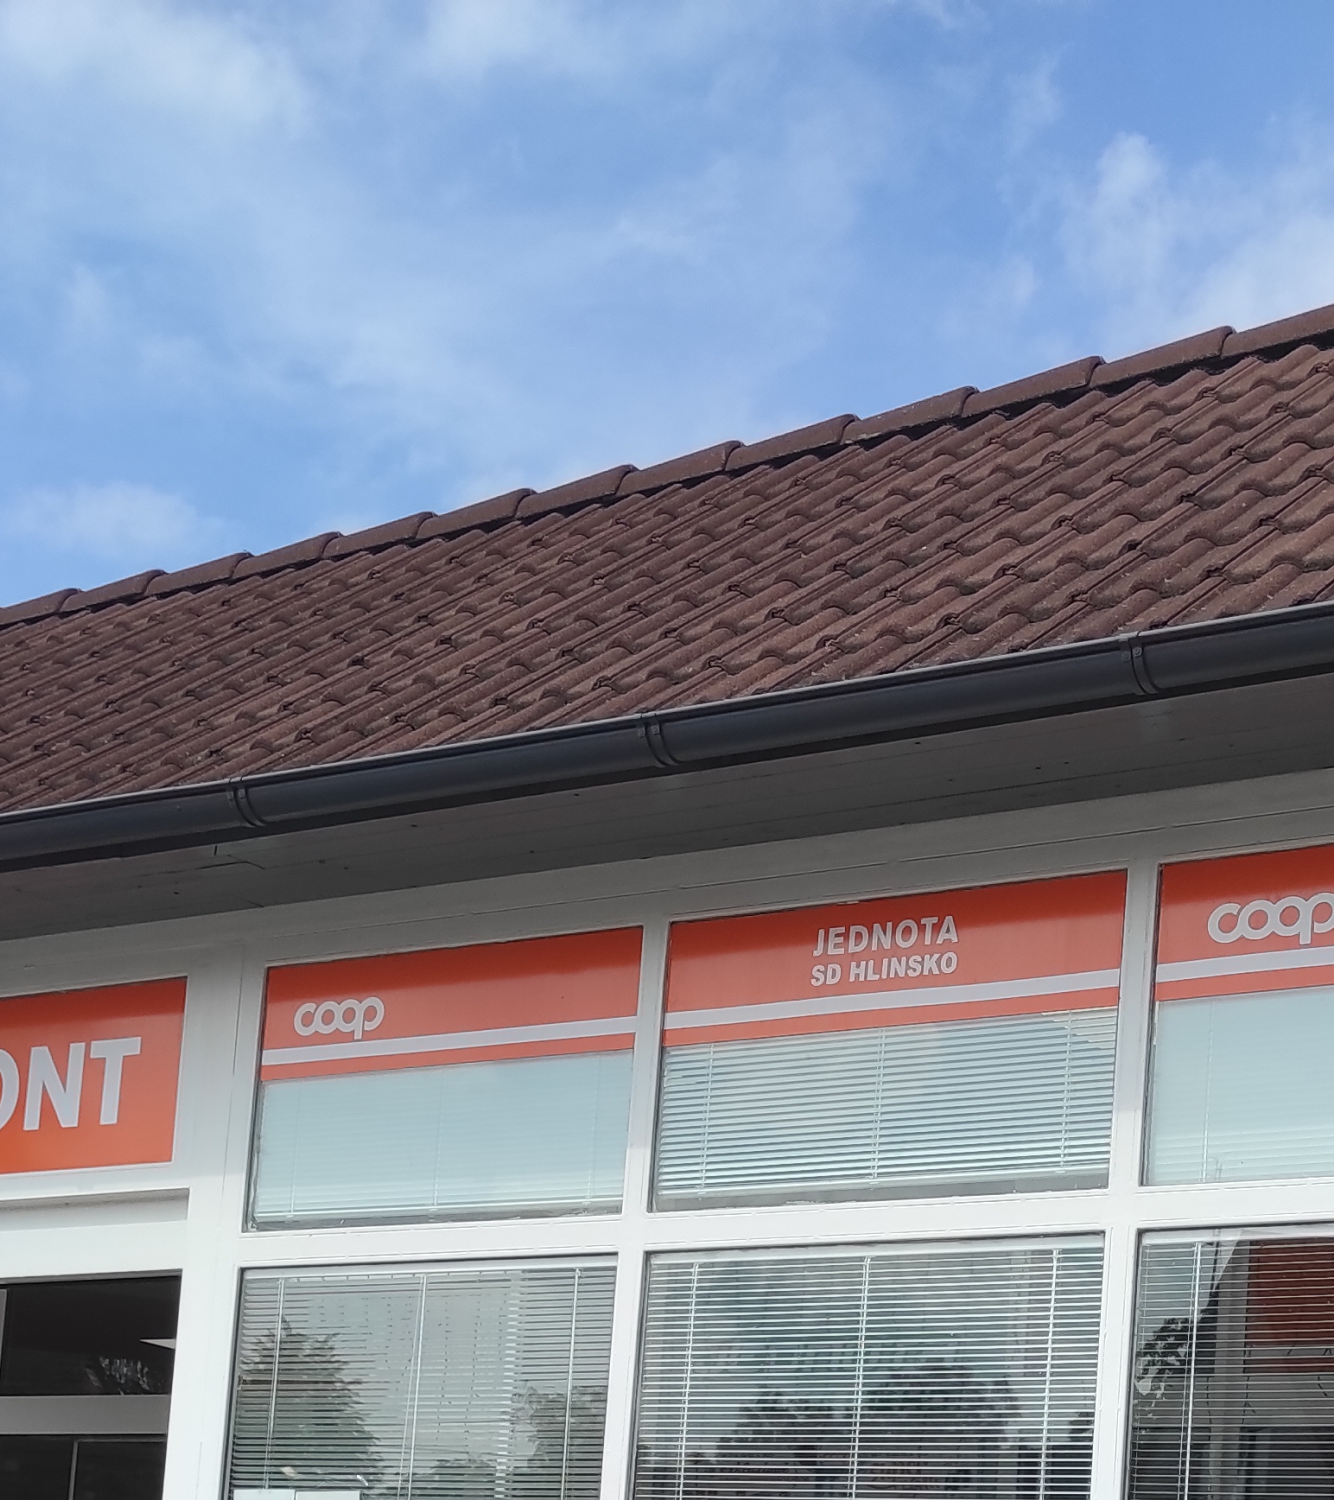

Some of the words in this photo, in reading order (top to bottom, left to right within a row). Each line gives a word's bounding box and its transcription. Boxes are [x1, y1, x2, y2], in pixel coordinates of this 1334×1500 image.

[812, 915, 959, 957] JEDNOTA
[810, 964, 842, 987] SD
[849, 952, 958, 982] HLINSKO
[293, 996, 385, 1040] coop
